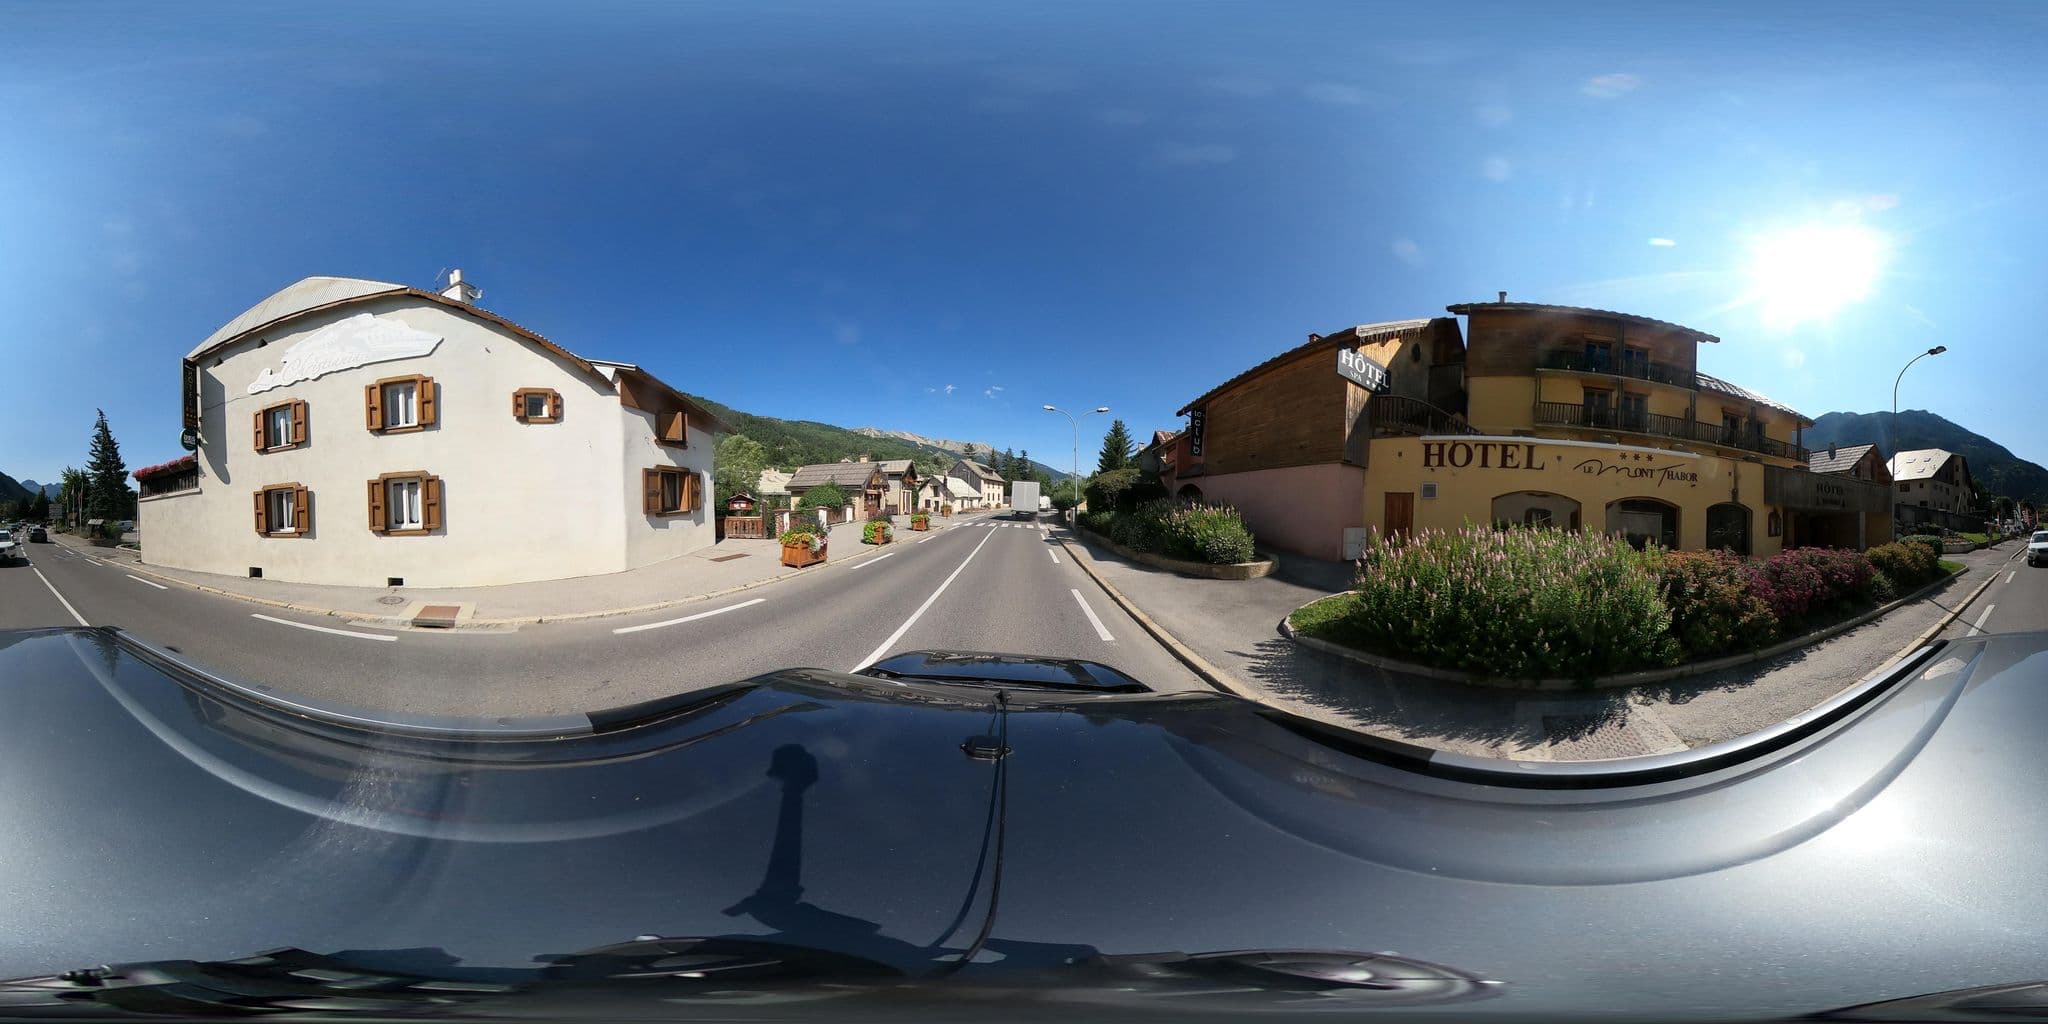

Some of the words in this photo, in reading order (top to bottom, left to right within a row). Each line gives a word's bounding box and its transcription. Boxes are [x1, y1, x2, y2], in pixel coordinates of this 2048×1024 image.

[1341, 349, 1389, 389] HÔTEL
[1350, 371, 1362, 382] SPA
[1657, 463, 1698, 487] THABOR
